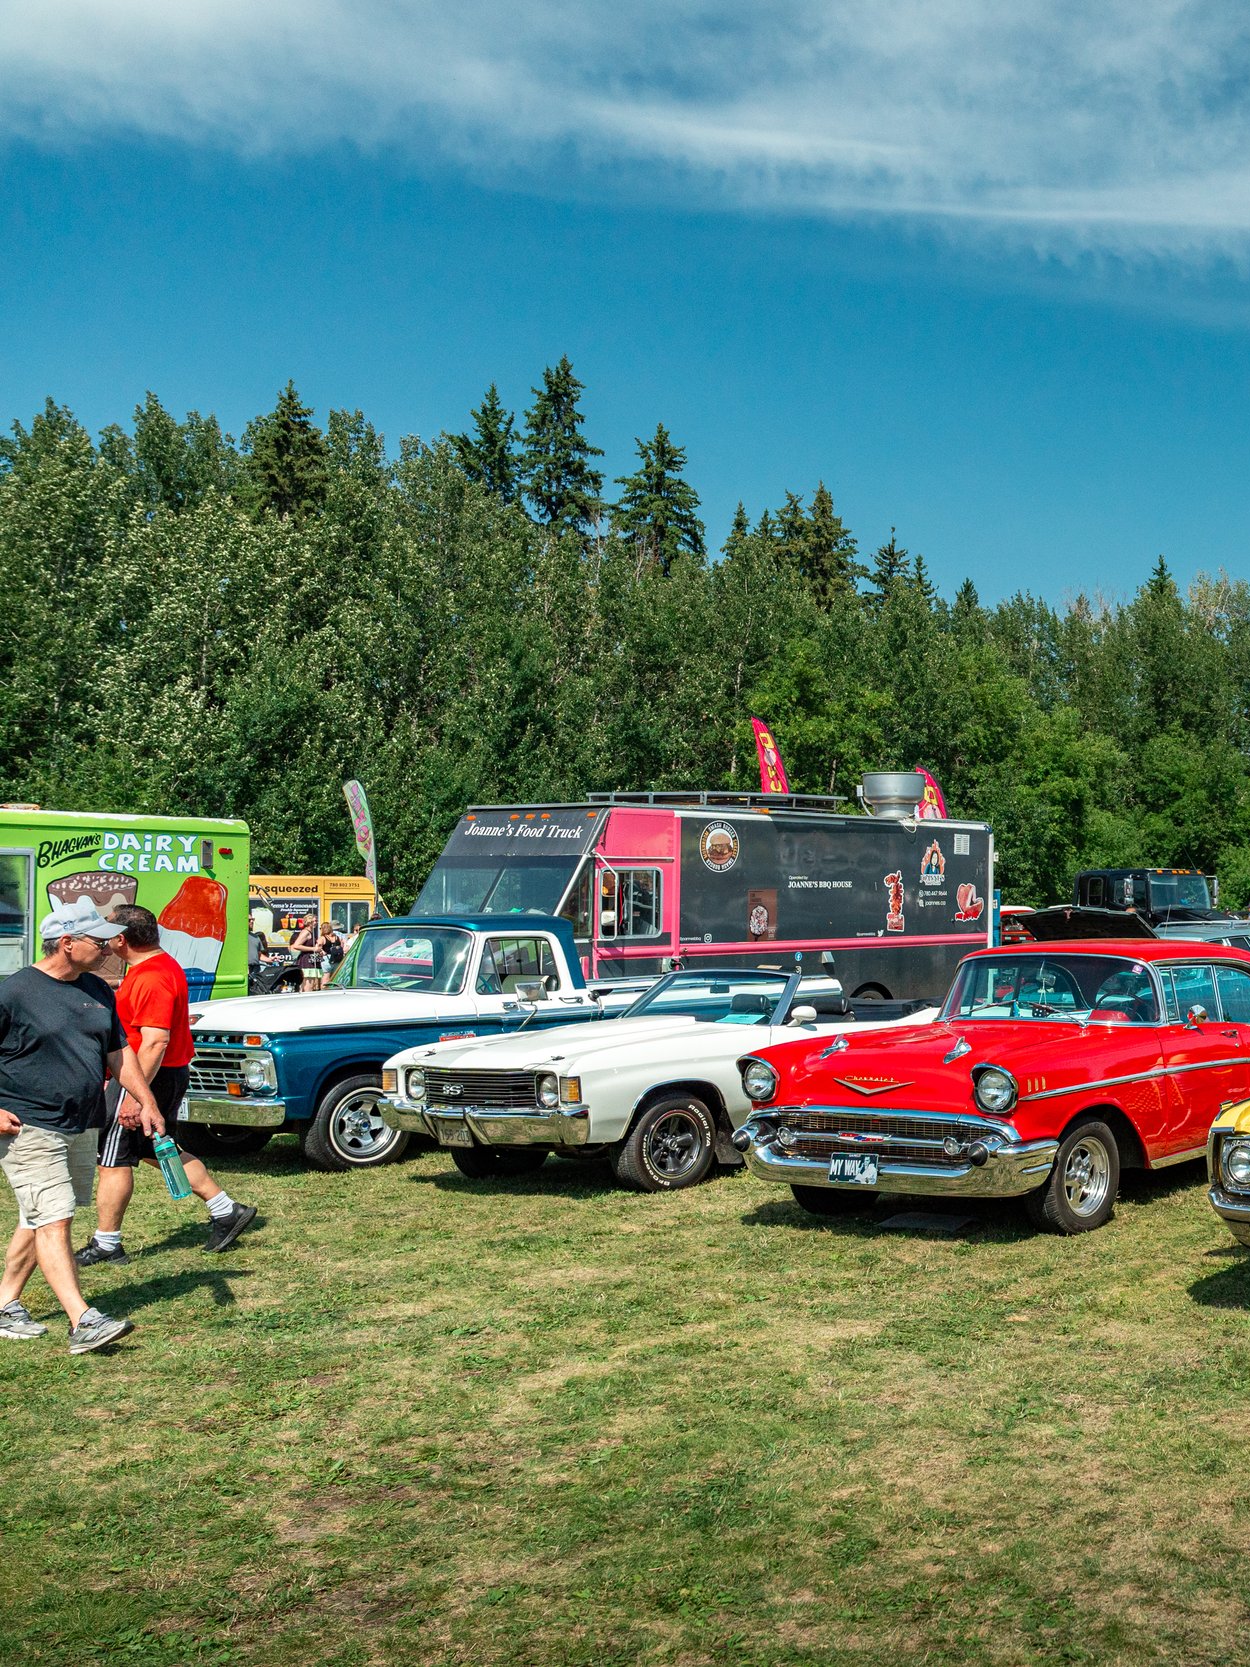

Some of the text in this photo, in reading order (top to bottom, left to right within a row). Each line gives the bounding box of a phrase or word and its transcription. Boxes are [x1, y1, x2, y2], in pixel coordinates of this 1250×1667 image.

[464, 823, 584, 838] Joanne's Food Truck
[37, 833, 102, 868] BHAGVAN'S
[98, 852, 200, 873] CREAM
[264, 885, 319, 895] squeezed
[788, 880, 853, 889] JOANNE'S BBQ HOUSE
[688, 1104, 710, 1129] Radial
[830, 1159, 862, 1176] MY WAY
